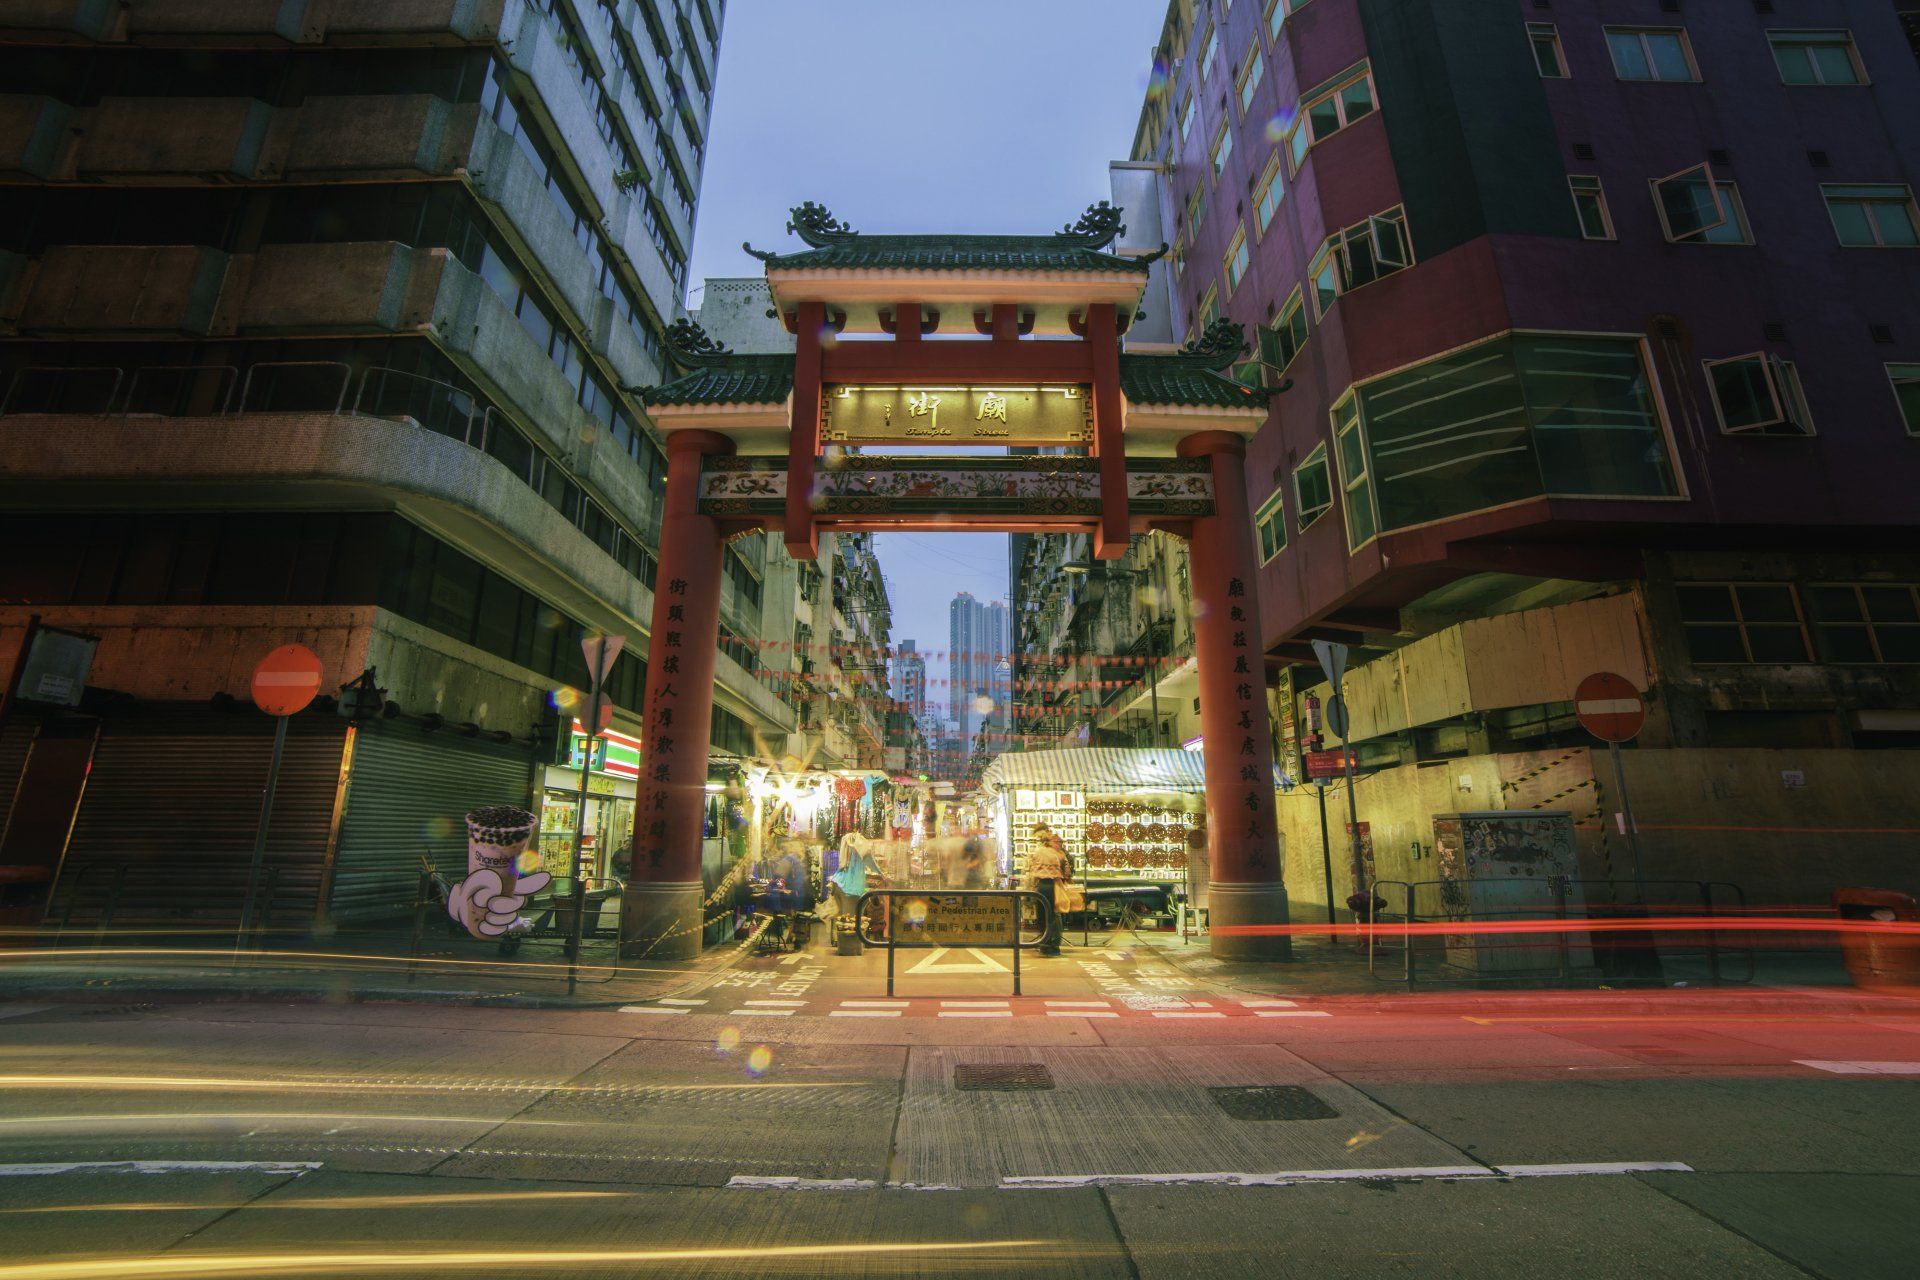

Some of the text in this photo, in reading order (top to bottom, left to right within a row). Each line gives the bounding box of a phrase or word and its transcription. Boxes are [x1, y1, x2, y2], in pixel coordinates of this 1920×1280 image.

[906, 428, 1009, 437] Temple Street
[941, 906, 987, 915] Pedestrian
[990, 907, 1010, 915] Area
